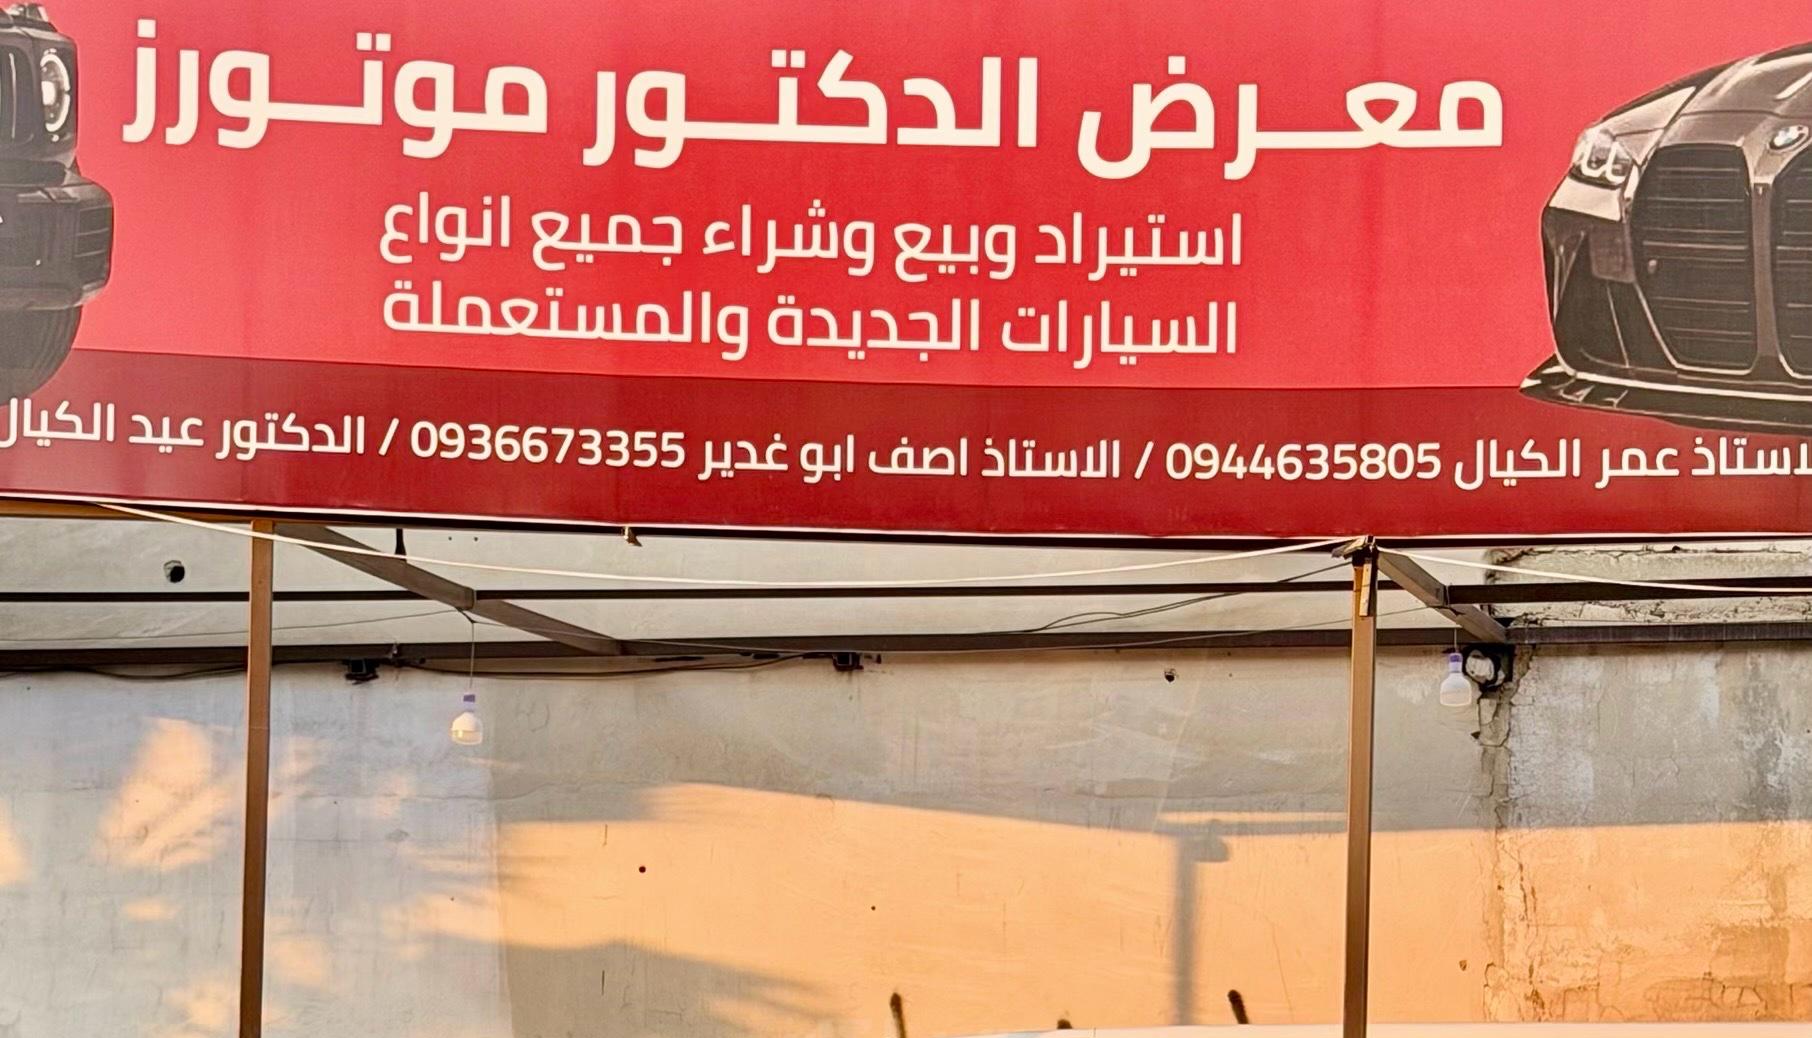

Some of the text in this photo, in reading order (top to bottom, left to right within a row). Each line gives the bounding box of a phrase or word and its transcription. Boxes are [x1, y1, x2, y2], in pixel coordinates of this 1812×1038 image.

[122, 20, 1503, 180] معرض الدكتور موتورز
[379, 191, 1241, 283] استيراد وبيع وشراء جميع انواع
[383, 280, 1236, 369] السيارات الجديدة والمستعملة
[128, 414, 205, 455] عيد
[215, 412, 365, 461] الدكتور
[379, 418, 400, 457] /
[411, 421, 685, 469] 0936673355
[697, 432, 788, 482] غدير
[868, 437, 968, 477] اصف
[981, 437, 1120, 478] الاستاذ
[800, 434, 854, 484] ابو
[1134, 441, 1154, 479] /
[1166, 442, 1441, 481] 0944635805
[1454, 437, 1581, 491] الكيال
[1595, 447, 1680, 489] عمر
